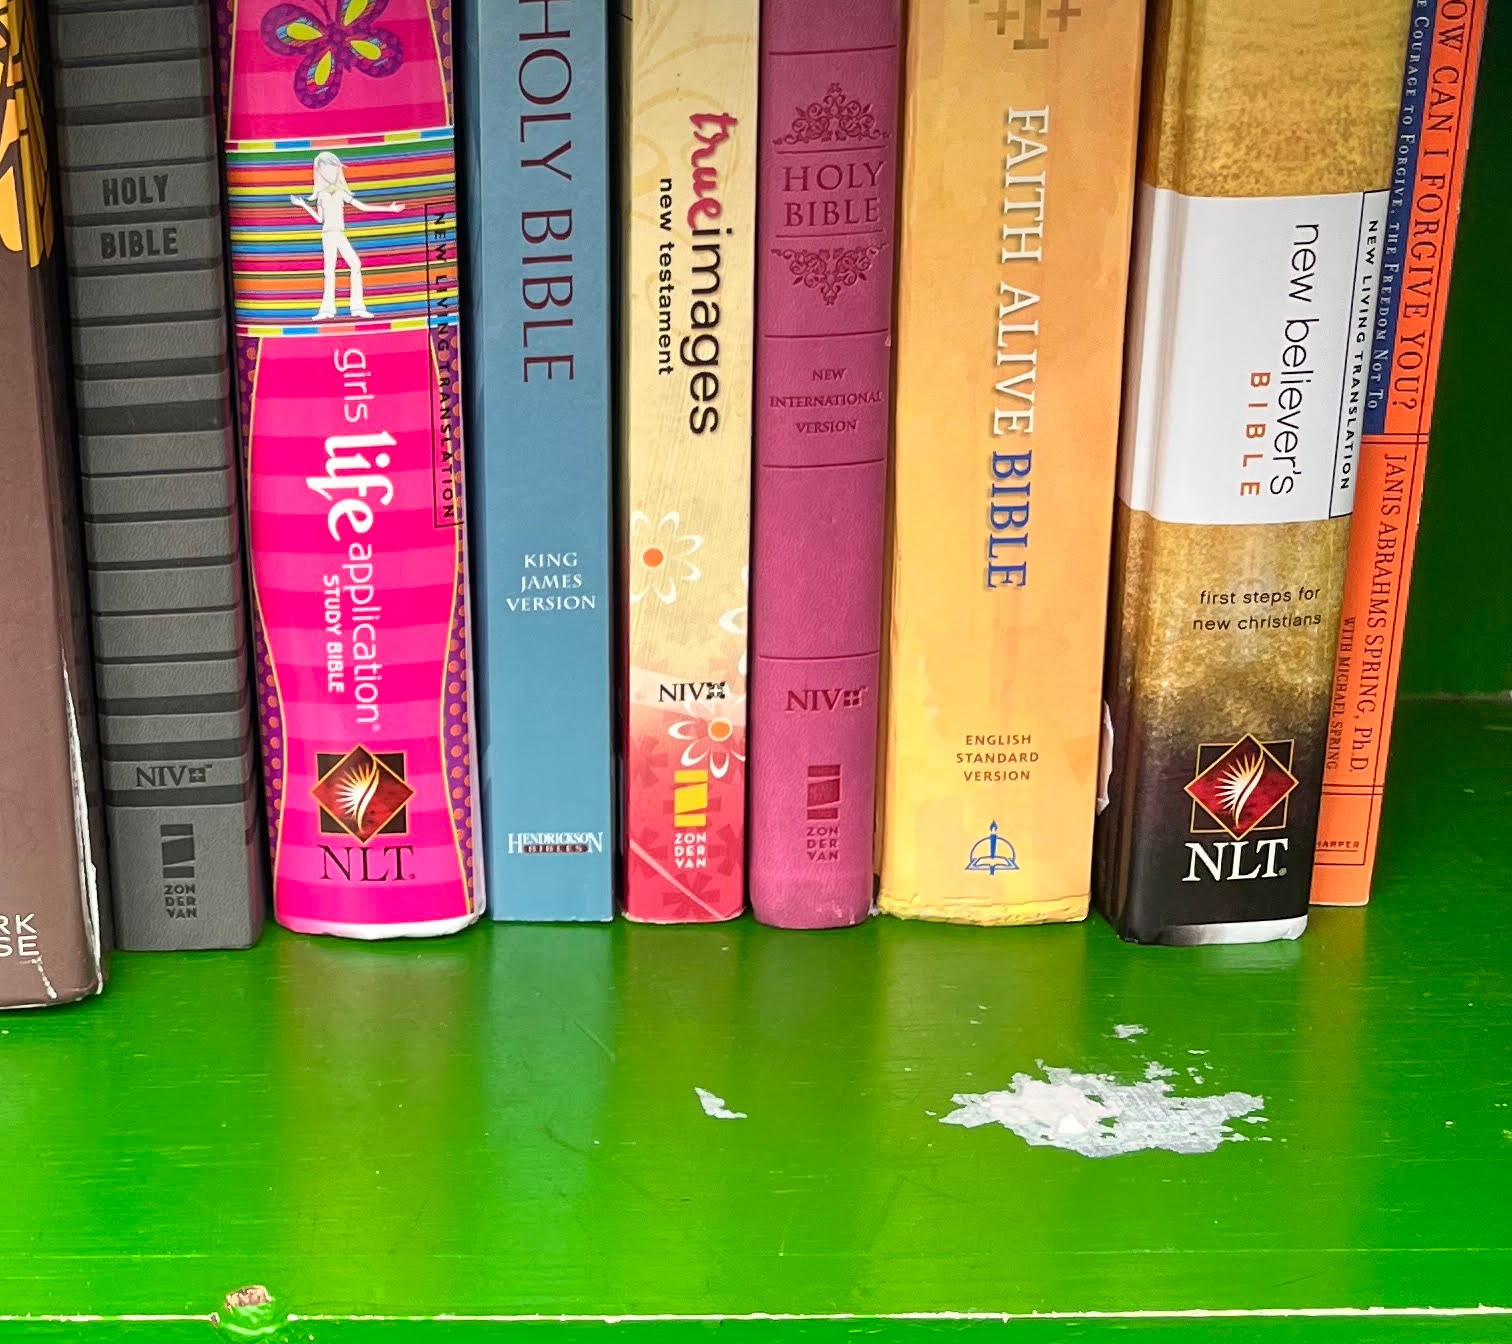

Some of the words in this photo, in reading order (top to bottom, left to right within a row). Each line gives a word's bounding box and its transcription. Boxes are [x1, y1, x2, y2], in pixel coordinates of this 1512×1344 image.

[1425, 64, 1460, 133] CAN
[1424, 147, 1449, 158] I
[102, 174, 169, 207] HOLY
[782, 160, 884, 192] HOLY
[1000, 105, 1050, 265] FAITH
[659, 177, 673, 231] new
[784, 197, 881, 228] BIBLE
[100, 227, 178, 260] BIBLE
[433, 211, 448, 263] NEW
[1365, 219, 1379, 266] NEW
[1402, 173, 1446, 320] FORGIVE
[1288, 222, 1320, 304] new
[434, 273, 449, 352] LIVING
[521, 209, 575, 384] BIBLE
[658, 243, 675, 375] testament
[1356, 275, 1373, 343] LIVING
[811, 368, 847, 382] NEW
[991, 281, 1041, 436] ALIVE
[1391, 330, 1435, 412] YOU?
[333, 348, 369, 423] girls
[770, 391, 883, 409] INTERNATIONAL
[1269, 318, 1320, 496] believer's
[1340, 351, 1364, 490] TRANSLATION
[438, 361, 456, 519] TRANSLATION
[795, 419, 858, 435] VERSION
[1240, 371, 1272, 497] BIBLE
[306, 431, 398, 542] life
[1380, 452, 1407, 517] JANIS
[986, 449, 1033, 589] BIBLE
[523, 552, 578, 569] KING
[1368, 522, 1397, 628] ABRAHMS
[520, 574, 582, 593] JAMES
[1200, 589, 1238, 606] first
[1242, 589, 1292, 608] steps
[1298, 586, 1322, 601] for
[323, 574, 343, 637] STUDY
[506, 595, 596, 613] VERSION
[1193, 617, 1230, 632] new
[1237, 612, 1323, 631] christians
[342, 542, 381, 725] application
[1339, 617, 1356, 654] WITH
[326, 641, 345, 694] BIBLE
[1332, 655, 1351, 718] MICHAEL
[1355, 634, 1385, 720] SPRING,
[658, 682, 706, 703] NIV
[785, 689, 843, 713] NIV
[956, 751, 1040, 765] STANDARD
[965, 734, 1033, 747] ENGLISH
[1326, 718, 1343, 770] SPRING
[135, 765, 185, 788] NIV
[963, 770, 1031, 782] VERSION
[507, 832, 604, 854] HENDRICKSON
[674, 833, 706, 844] ZON
[806, 826, 839, 837] ZON
[807, 838, 839, 850] DER
[318, 843, 415, 883] NLT
[674, 846, 705, 856] DER
[675, 858, 706, 869] VAN
[807, 851, 839, 862] VAN
[1182, 838, 1289, 883] NLT
[164, 884, 196, 896] ZON
[165, 896, 197, 907] DER
[166, 907, 198, 919] VAN
